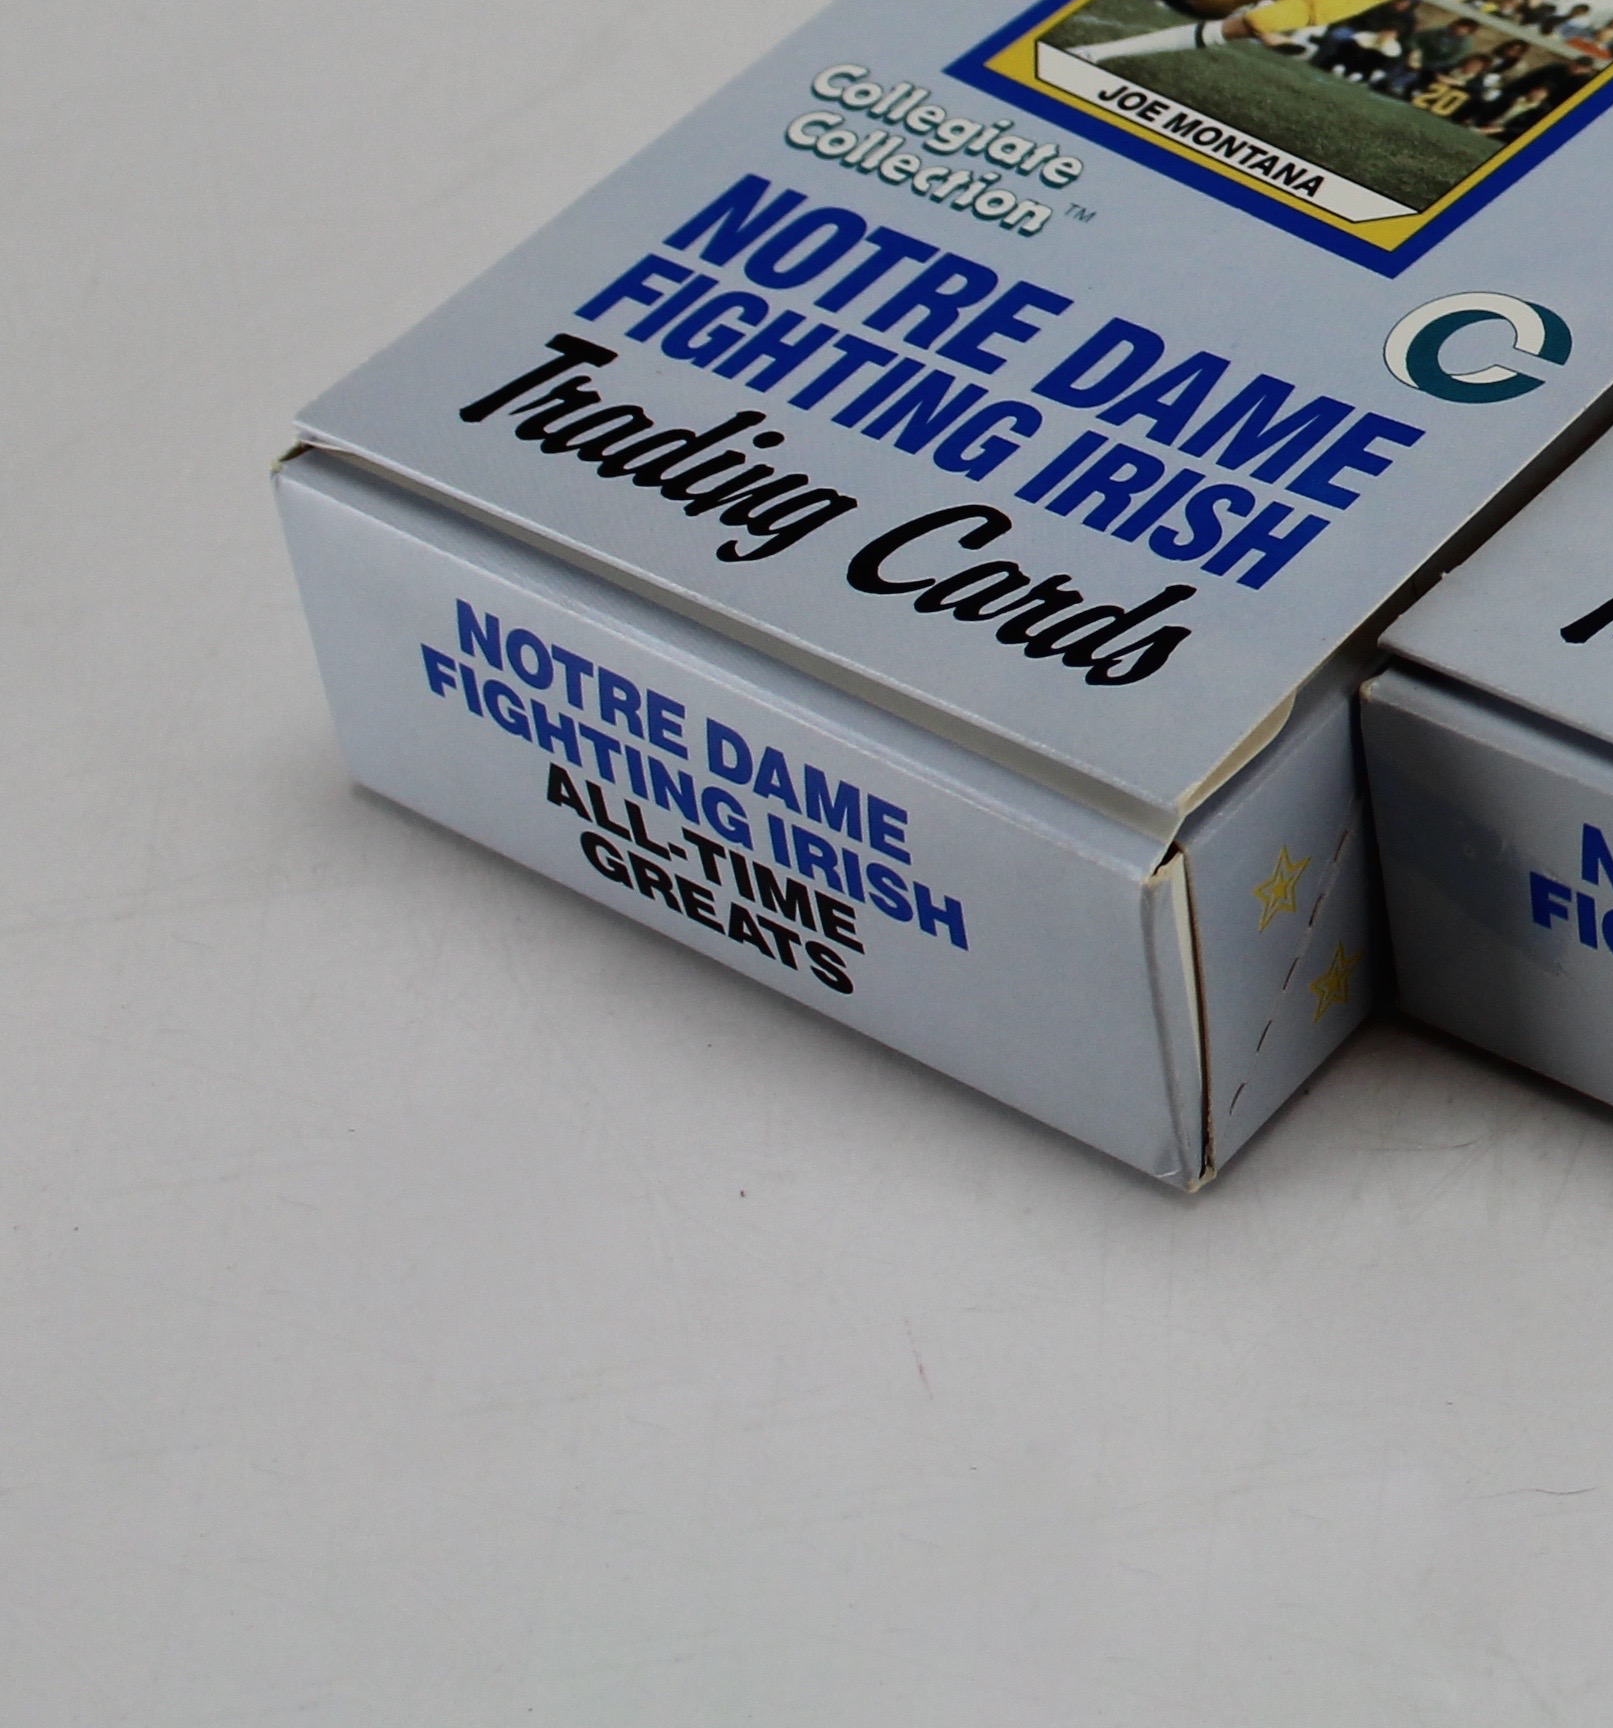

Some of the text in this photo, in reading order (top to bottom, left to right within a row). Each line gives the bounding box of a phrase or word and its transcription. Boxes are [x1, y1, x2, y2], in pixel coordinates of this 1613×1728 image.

[786, 111, 1053, 237] Collection
[810, 64, 1084, 188] Collegiate
[1098, 83, 1327, 199] JOE MONTANA
[574, 256, 1330, 590] FIGHTING IRISH
[664, 173, 1425, 510] NOTRE DAME
[459, 333, 1197, 686] Trading Cards
[421, 643, 969, 951] FIGHTING IRISH
[456, 598, 912, 865] NOTRE DAME
[546, 763, 864, 956] ALL-TIME
[580, 831, 854, 995] GREATS
